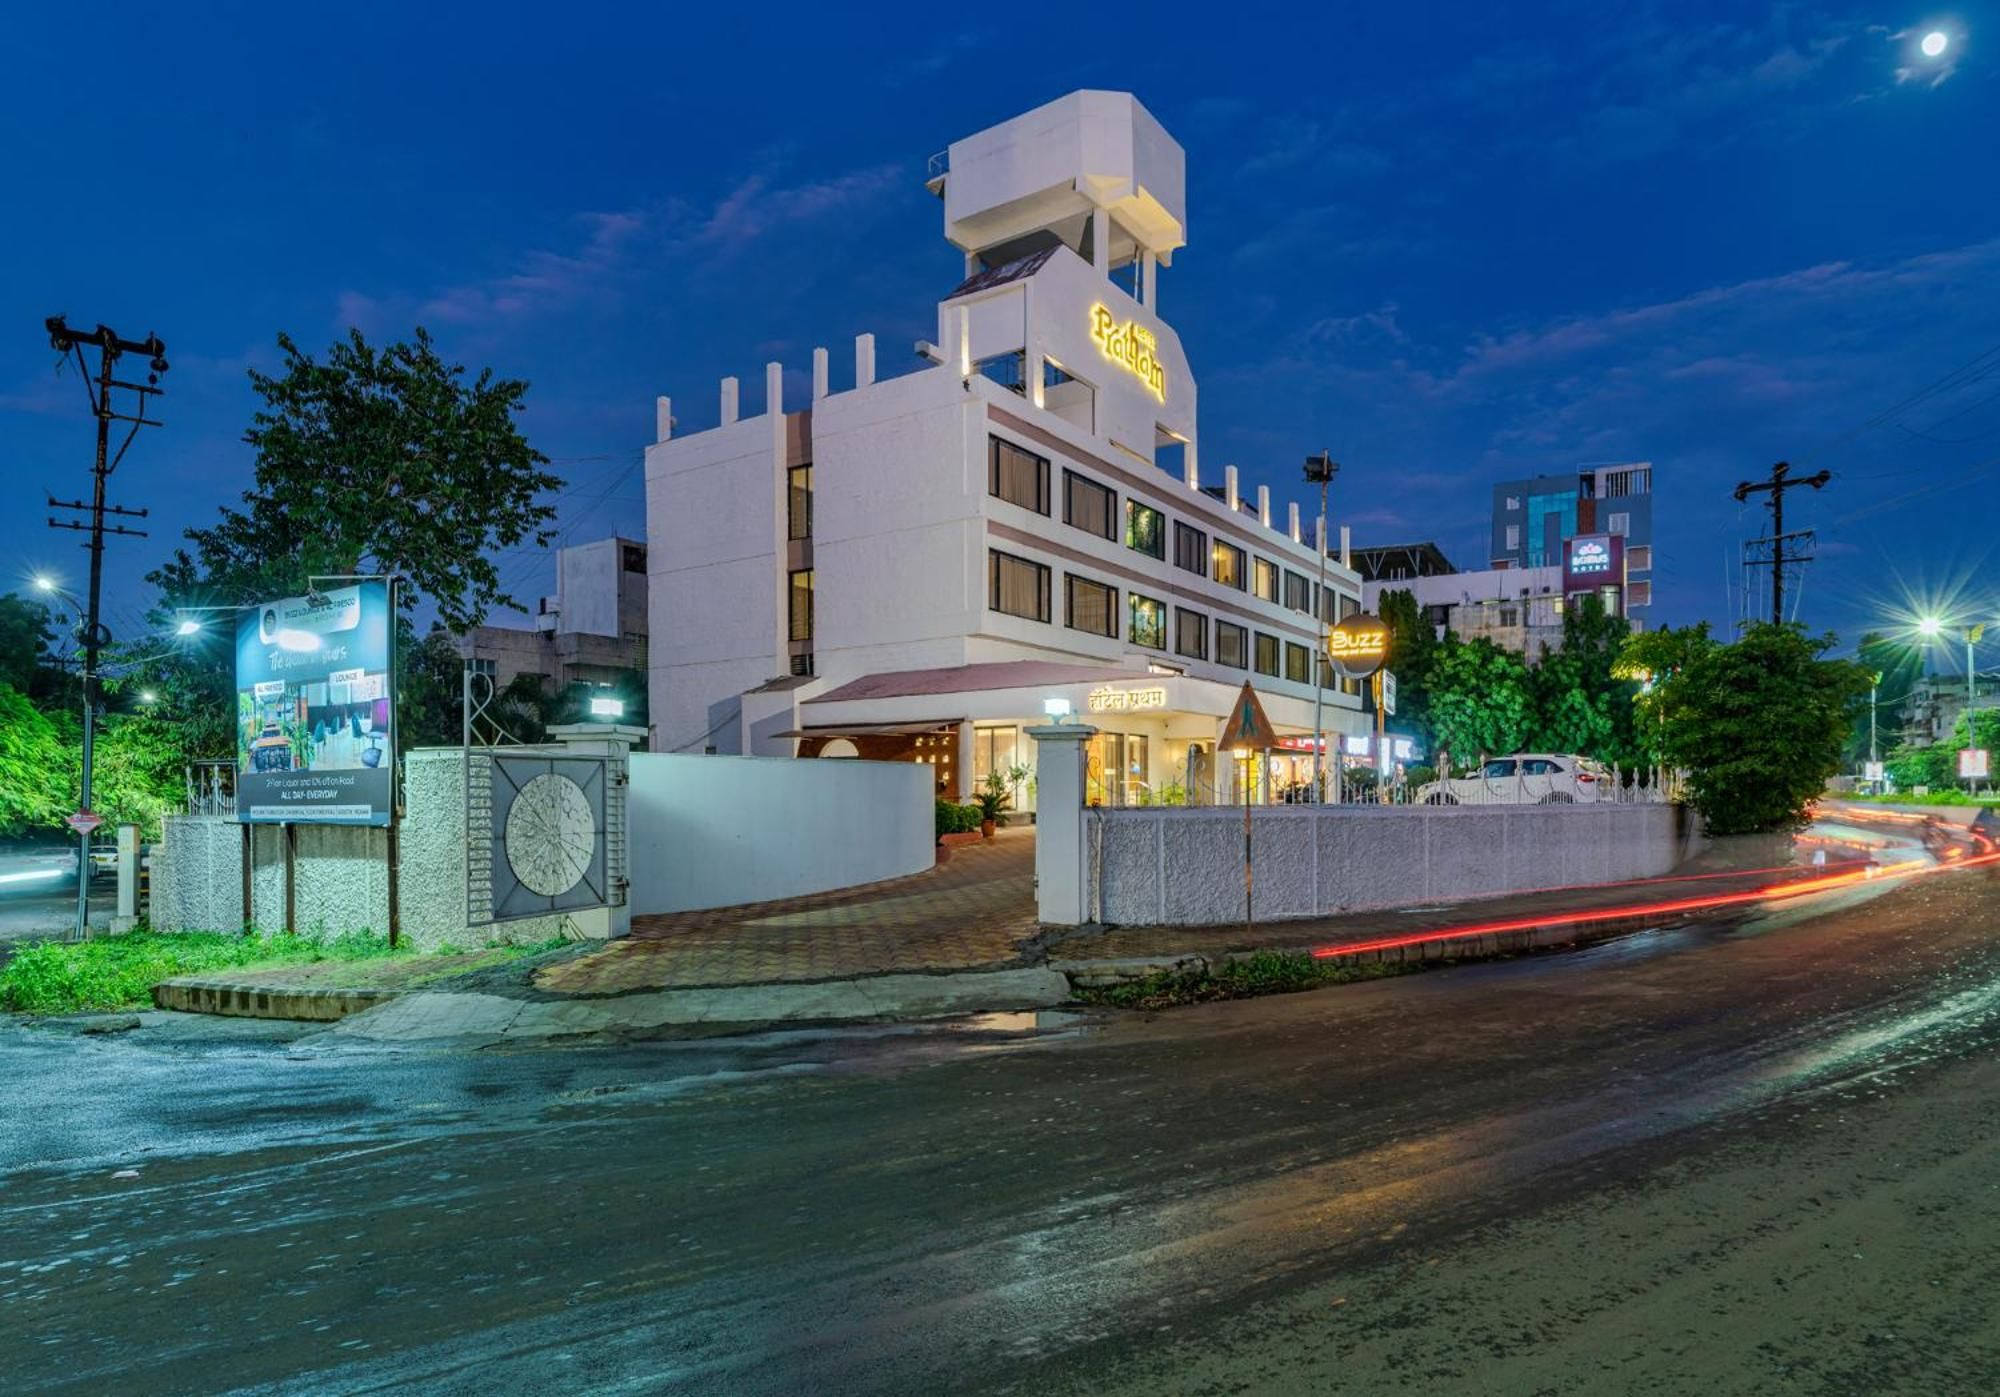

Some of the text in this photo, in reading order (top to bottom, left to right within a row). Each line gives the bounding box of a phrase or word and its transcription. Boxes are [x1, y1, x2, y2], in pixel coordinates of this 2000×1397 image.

[1091, 303, 1167, 403] Pratham
[334, 672, 358, 683] LOUNGE
[1127, 688, 1164, 707] प्रथम
